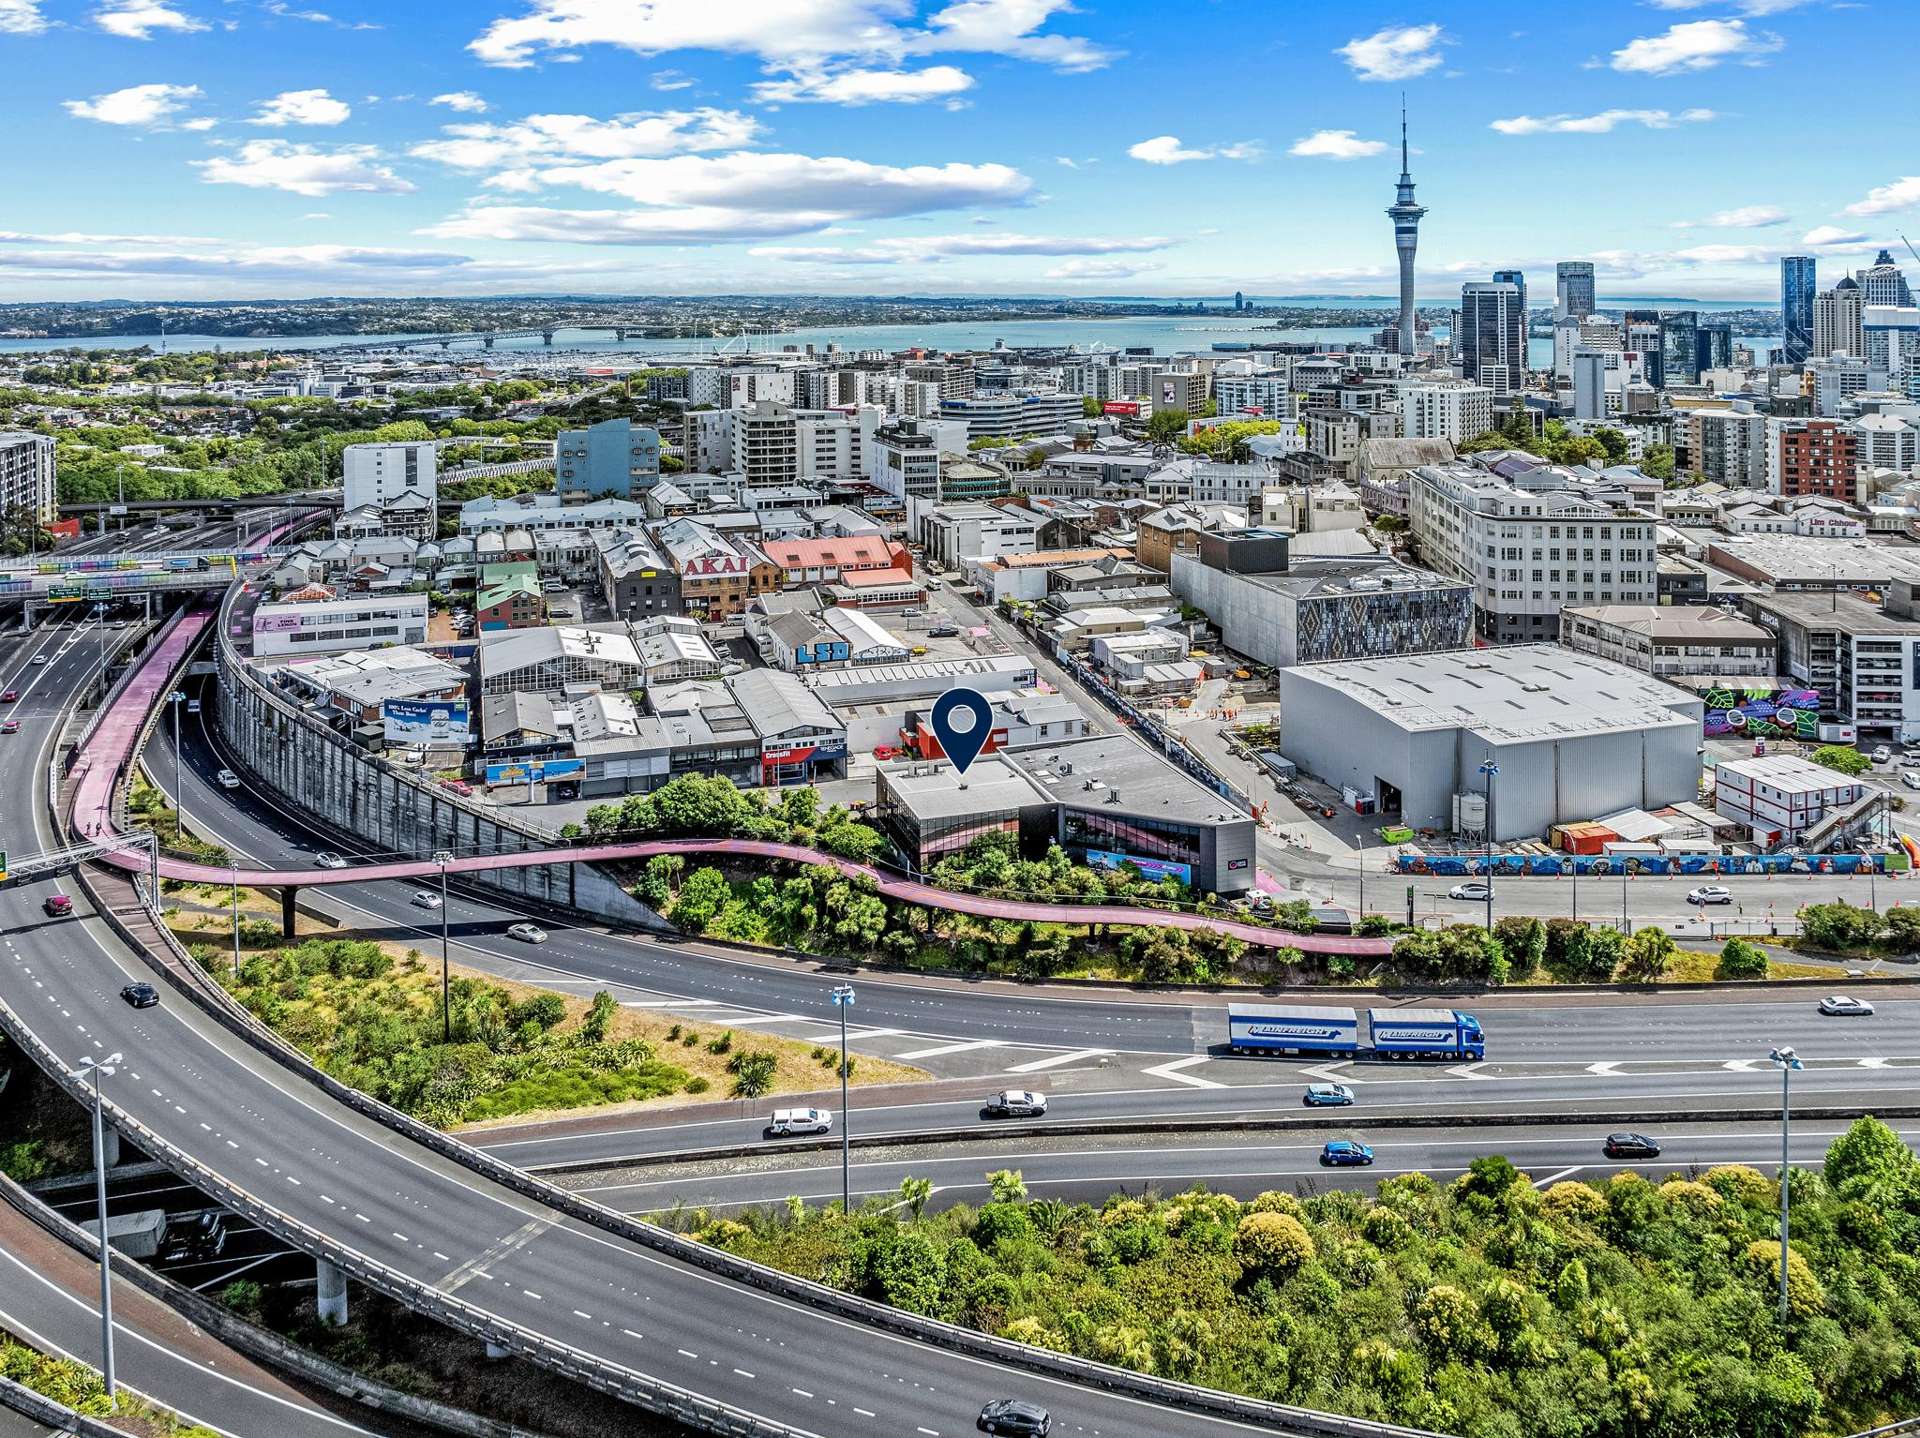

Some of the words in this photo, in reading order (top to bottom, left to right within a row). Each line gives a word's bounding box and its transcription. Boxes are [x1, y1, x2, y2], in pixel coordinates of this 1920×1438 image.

[684, 557, 748, 576] AKAI
[796, 641, 849, 664] LSD
[1248, 1025, 1335, 1038] MAINFREIGHT
[1379, 1030, 1447, 1042] MAINFREIGHT
